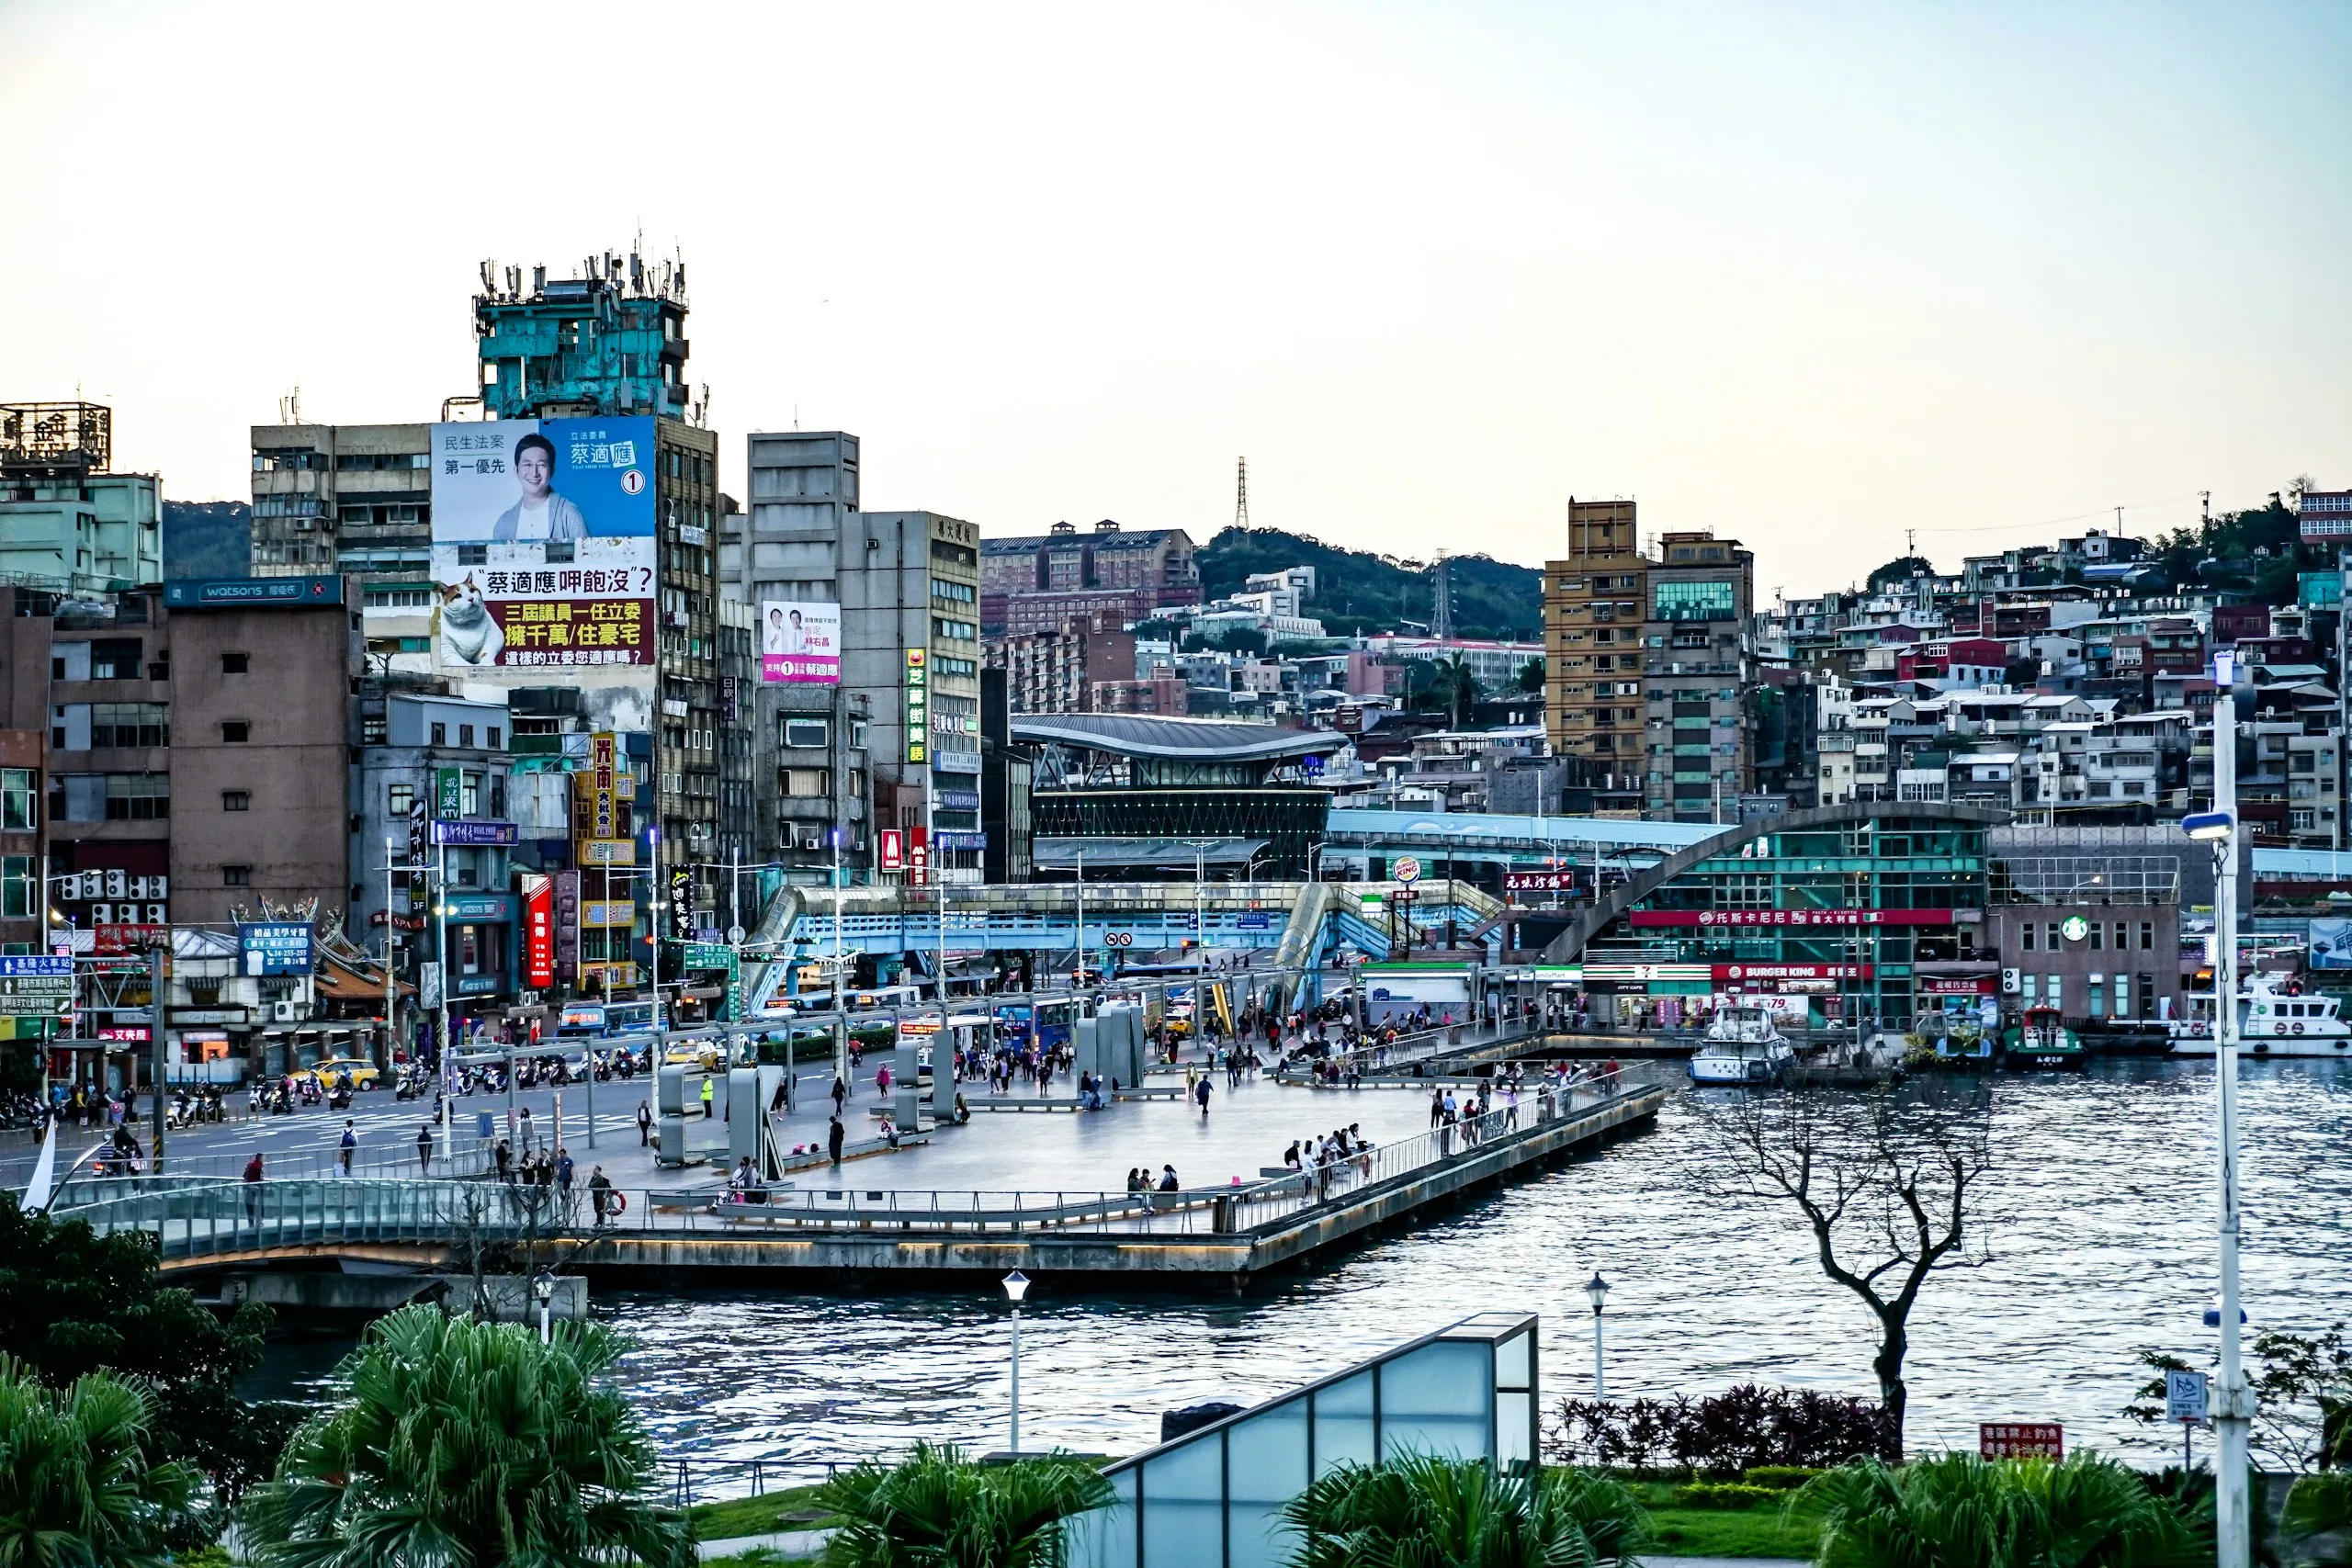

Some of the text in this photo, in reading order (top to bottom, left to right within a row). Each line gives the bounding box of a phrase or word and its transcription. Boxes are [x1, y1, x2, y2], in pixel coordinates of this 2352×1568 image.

[571, 431, 606, 440] 立法委員
[445, 434, 504, 450] 民生法案
[571, 442, 633, 465] 蔡適應
[445, 458, 505, 475] 第一優先
[207, 586, 263, 597] watsons
[505, 602, 641, 622] 三屆議員一任立委
[505, 624, 640, 647] 擁千萬/住豪宅
[805, 637, 830, 647] 林右昌
[765, 663, 780, 672] 支持
[806, 663, 838, 676] 蔡適應
[441, 808, 458, 818] KTV
[1396, 861, 1417, 871] BURGER
[1397, 866, 1418, 876] KING
[413, 902, 424, 910] 3F
[1190, 913, 1197, 922] P
[1716, 912, 1785, 924] 托斯卡尼尼
[392, 918, 412, 929] SPA
[17, 957, 71, 968] 基隆火車站
[1746, 967, 1787, 976] BURGER
[1789, 967, 1815, 976] KING
[1936, 980, 1977, 989] 遊艇售票處
[1984, 1427, 2058, 1439] 港區禁止釣魚
